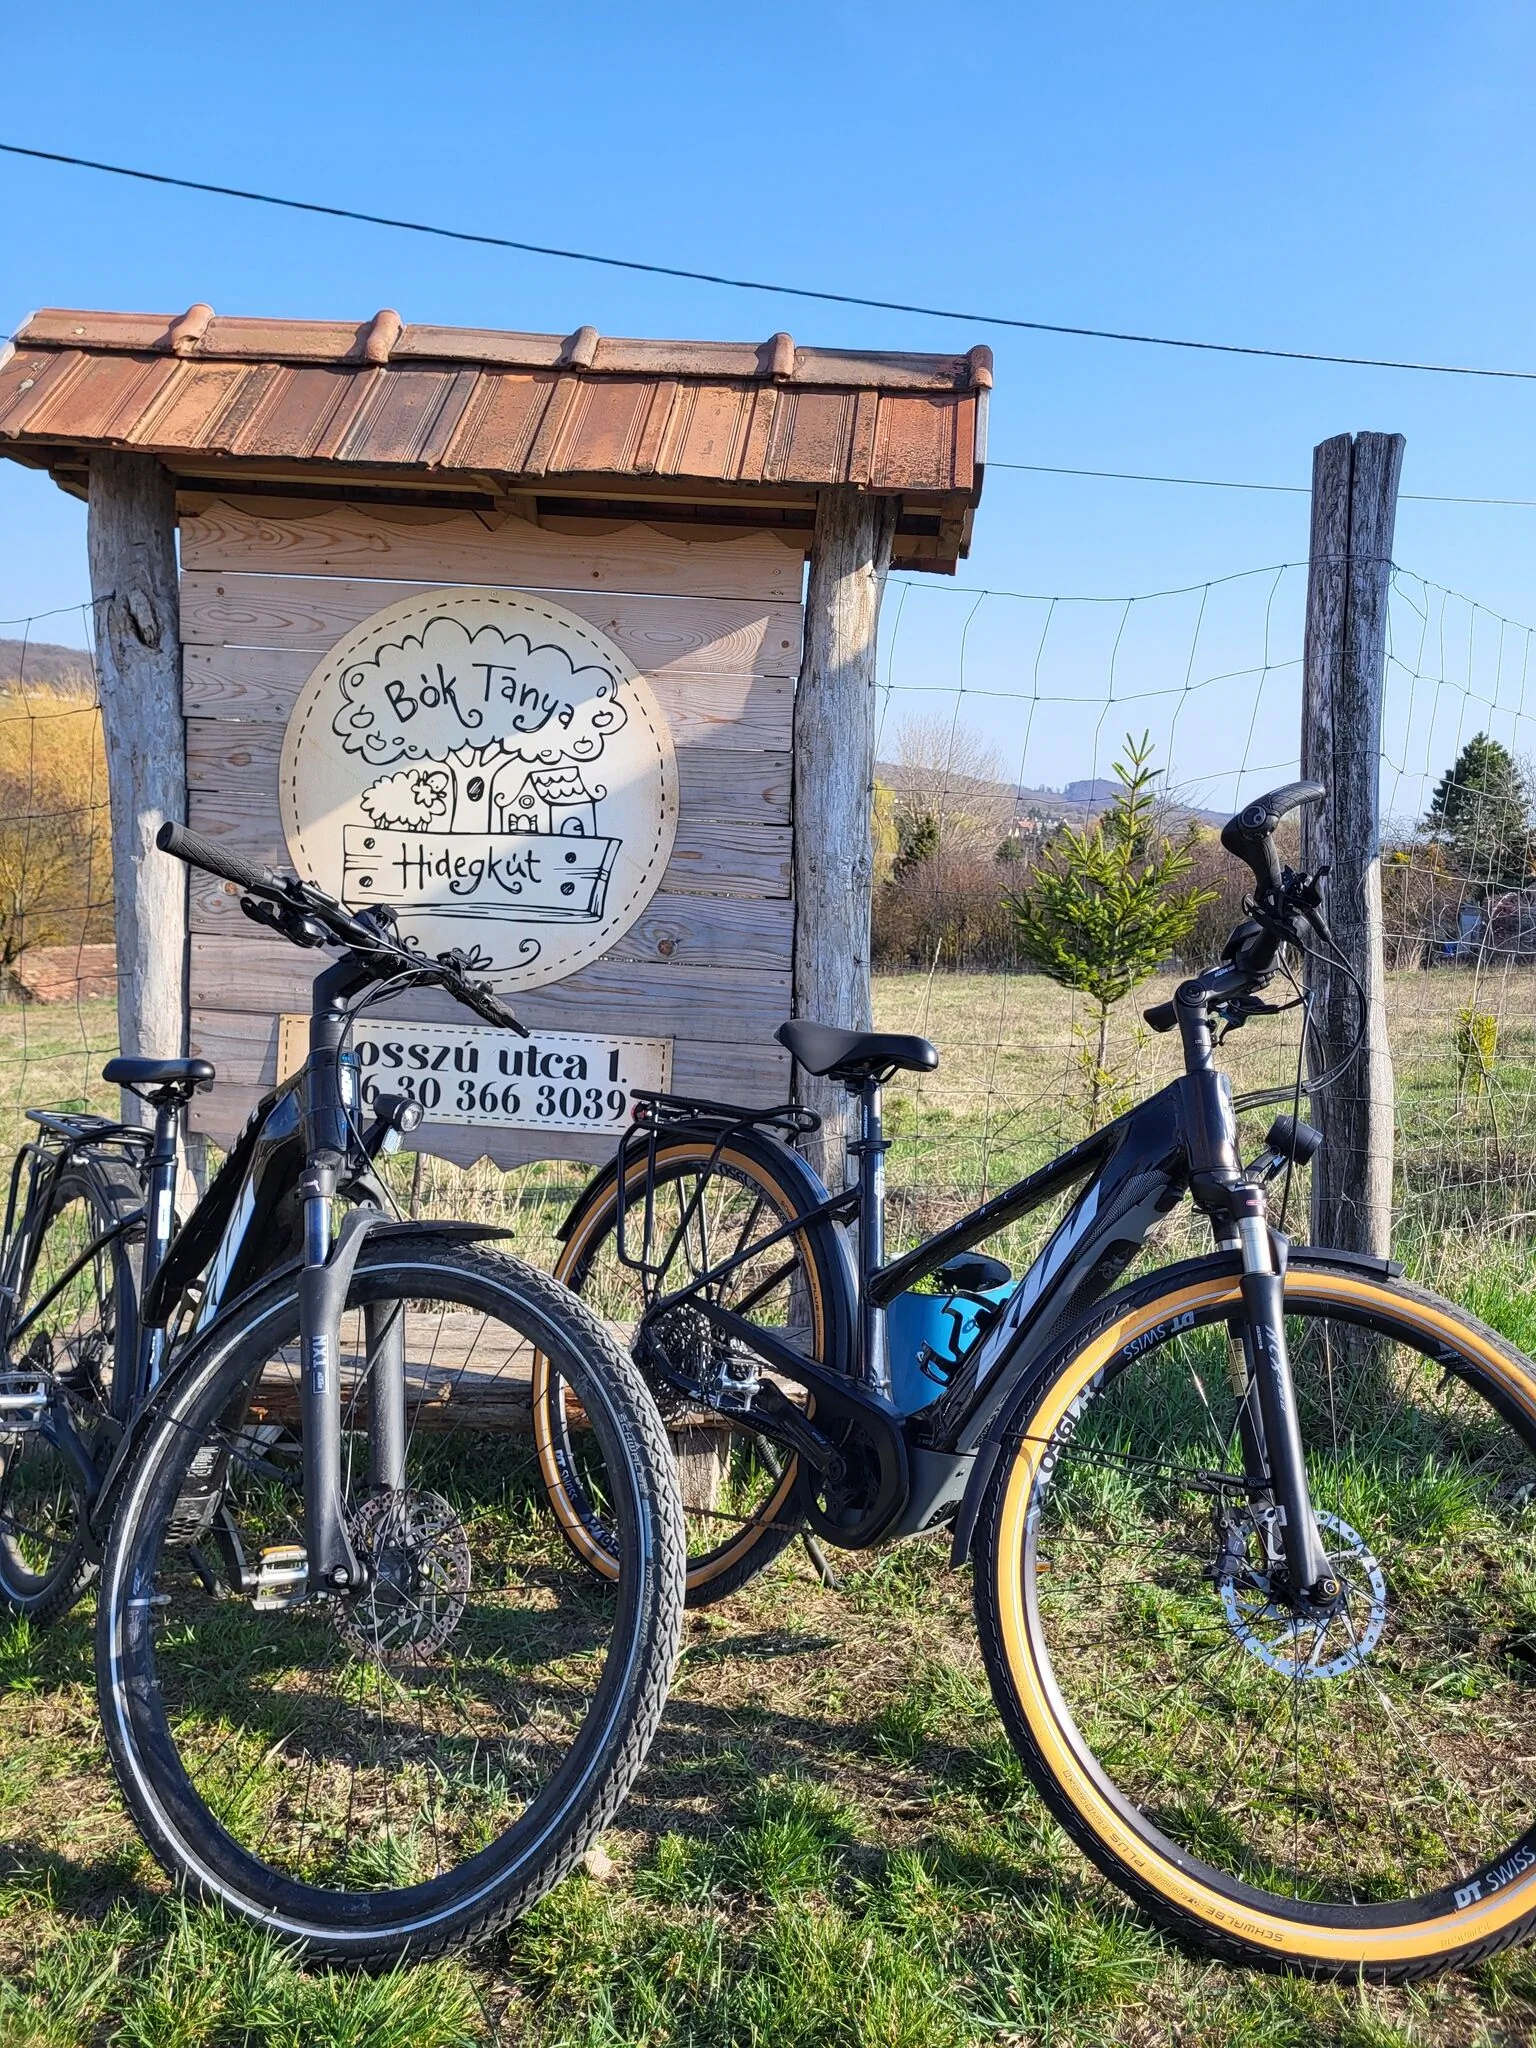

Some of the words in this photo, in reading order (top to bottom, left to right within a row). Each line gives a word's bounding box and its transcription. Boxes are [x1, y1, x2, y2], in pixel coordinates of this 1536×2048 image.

[384, 663, 484, 729] Bók
[471, 662, 576, 734] Tanya
[392, 842, 542, 895] Hidegkút
[355, 1040, 479, 1074] osszú
[499, 1044, 588, 1081] utca
[606, 1048, 628, 1083] 1.
[396, 1075, 441, 1110] 30
[456, 1078, 521, 1114] 366
[536, 1084, 627, 1121] 3039
[1122, 1323, 1167, 1361] SWISS
[1170, 1309, 1196, 1333] DT
[555, 1448, 567, 1468] DT
[561, 1469, 579, 1501] SWISS
[616, 1411, 649, 1495] SCHWALBE
[1109, 1832, 1146, 1869] PLUS
[1453, 1880, 1482, 1909] DT
[1485, 1844, 1536, 1892] SWISS
[1204, 1906, 1285, 1944] SCHWALBE
